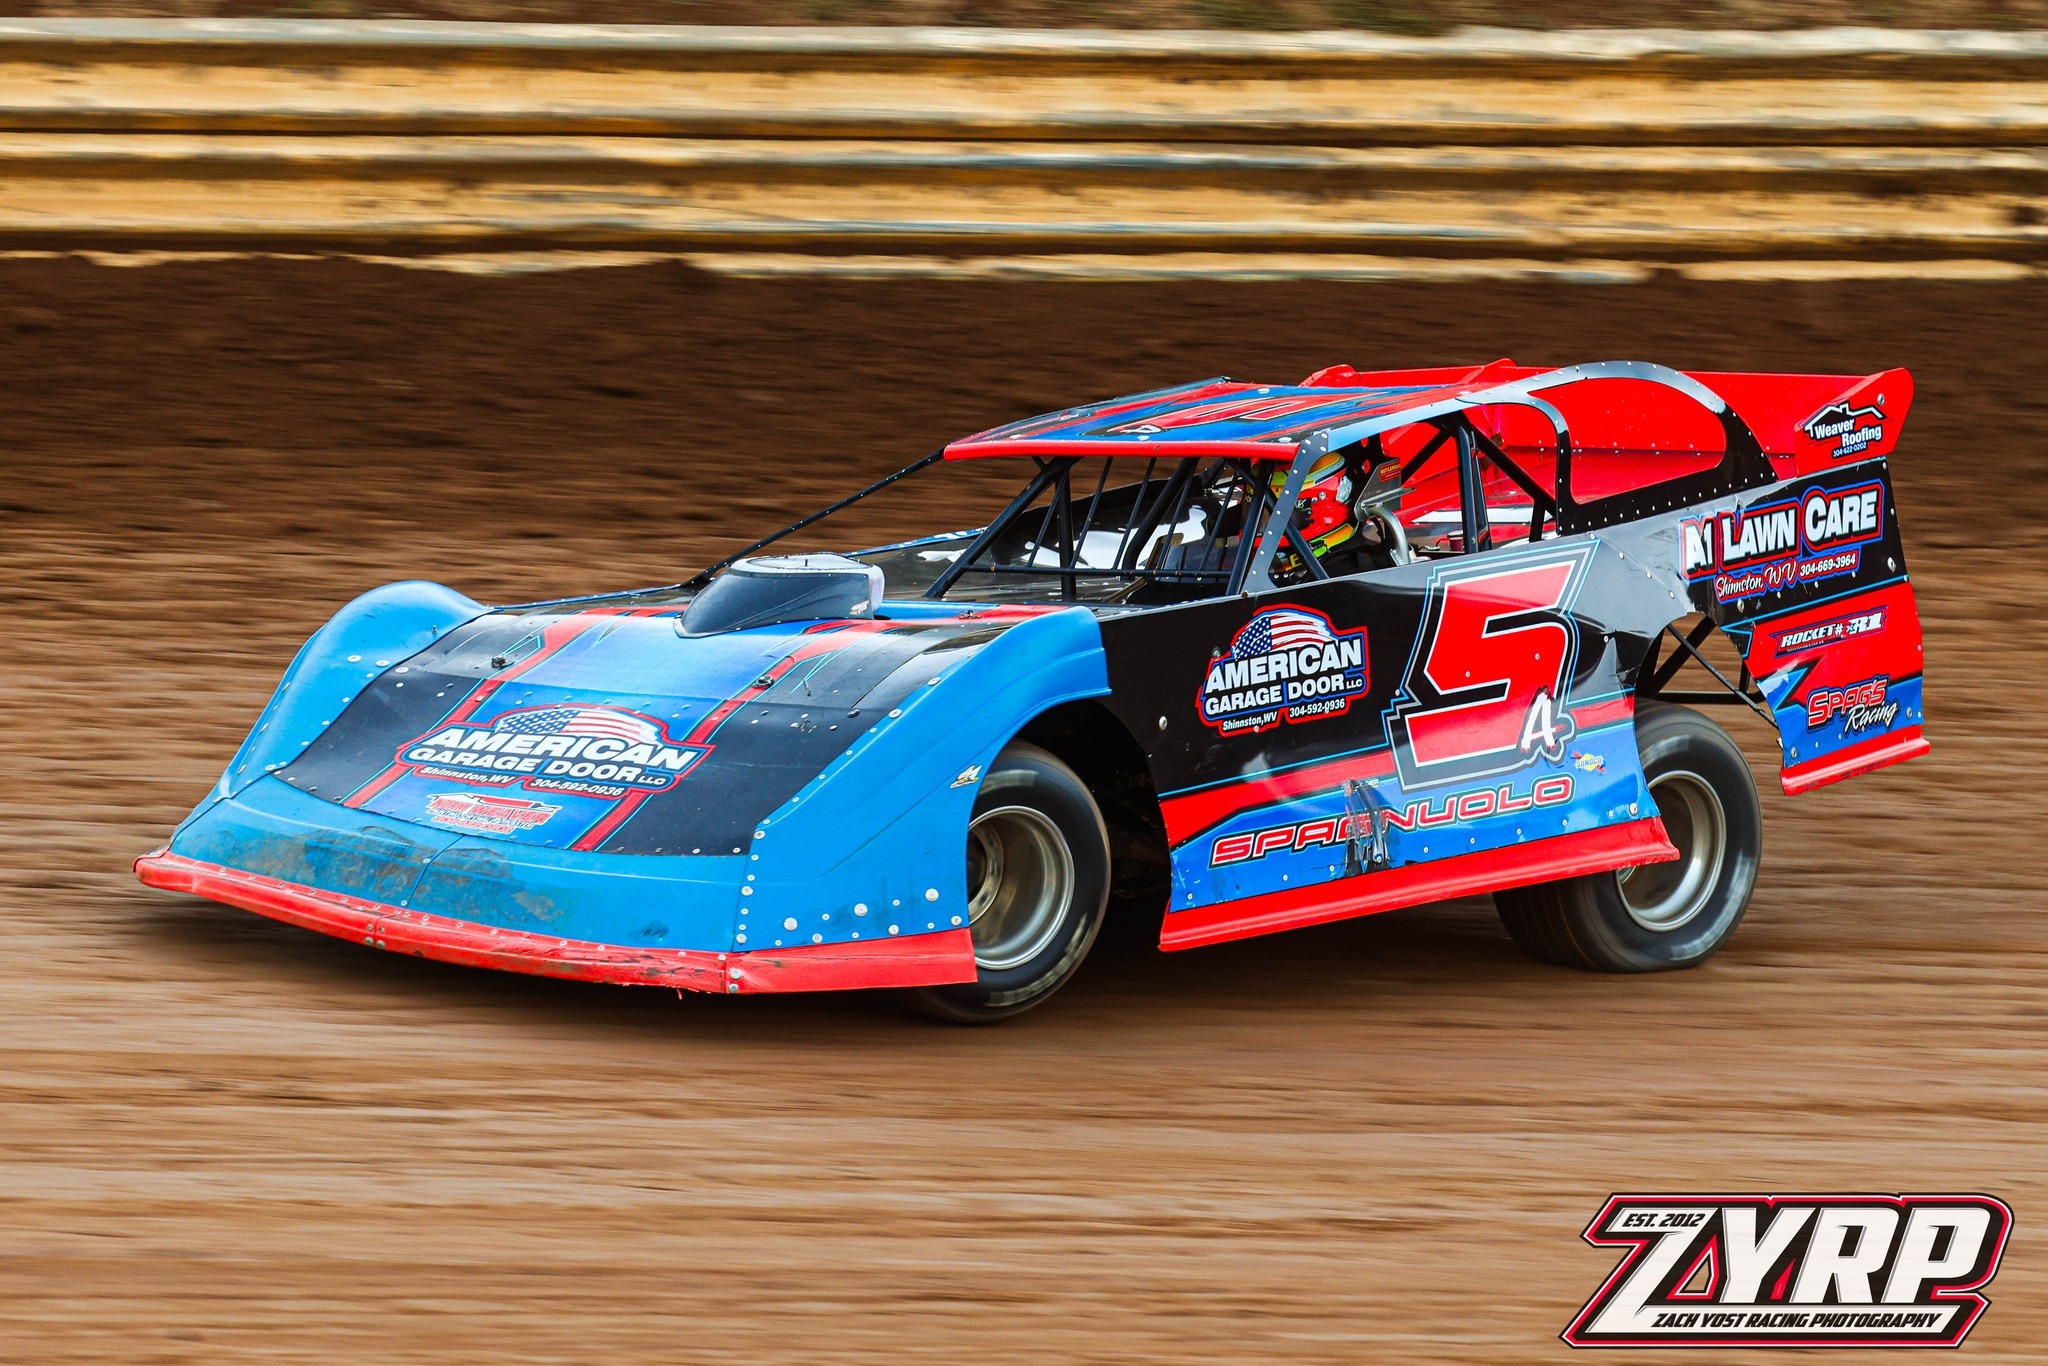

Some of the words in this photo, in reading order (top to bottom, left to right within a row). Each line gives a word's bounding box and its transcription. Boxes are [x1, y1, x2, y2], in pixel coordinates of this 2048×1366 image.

[1814, 418, 1855, 440] Weaver
[1841, 425, 1882, 447] Roofing
[1685, 518, 1714, 573] A1
[1720, 507, 1796, 561] LAWN
[1804, 489, 1879, 543] CARE
[1799, 552, 1857, 577] 304-669-3964
[1204, 638, 1362, 694] AMERICAN
[1404, 558, 1577, 769] 5
[1205, 684, 1283, 716] GARAGE
[1287, 673, 1346, 701] DOOR
[1346, 678, 1363, 690] LLC
[1288, 697, 1346, 719] 304-592-0936
[1520, 691, 1556, 750] A
[1844, 700, 1898, 733] Racing
[427, 727, 699, 770] AMERICAN
[1576, 757, 1602, 768] SUNOCO
[408, 748, 544, 773] GARAGE
[543, 759, 644, 783] DOOR
[636, 774, 668, 787] LLC
[529, 777, 626, 797] 304-592-0936
[468, 804, 553, 823] WEAVER
